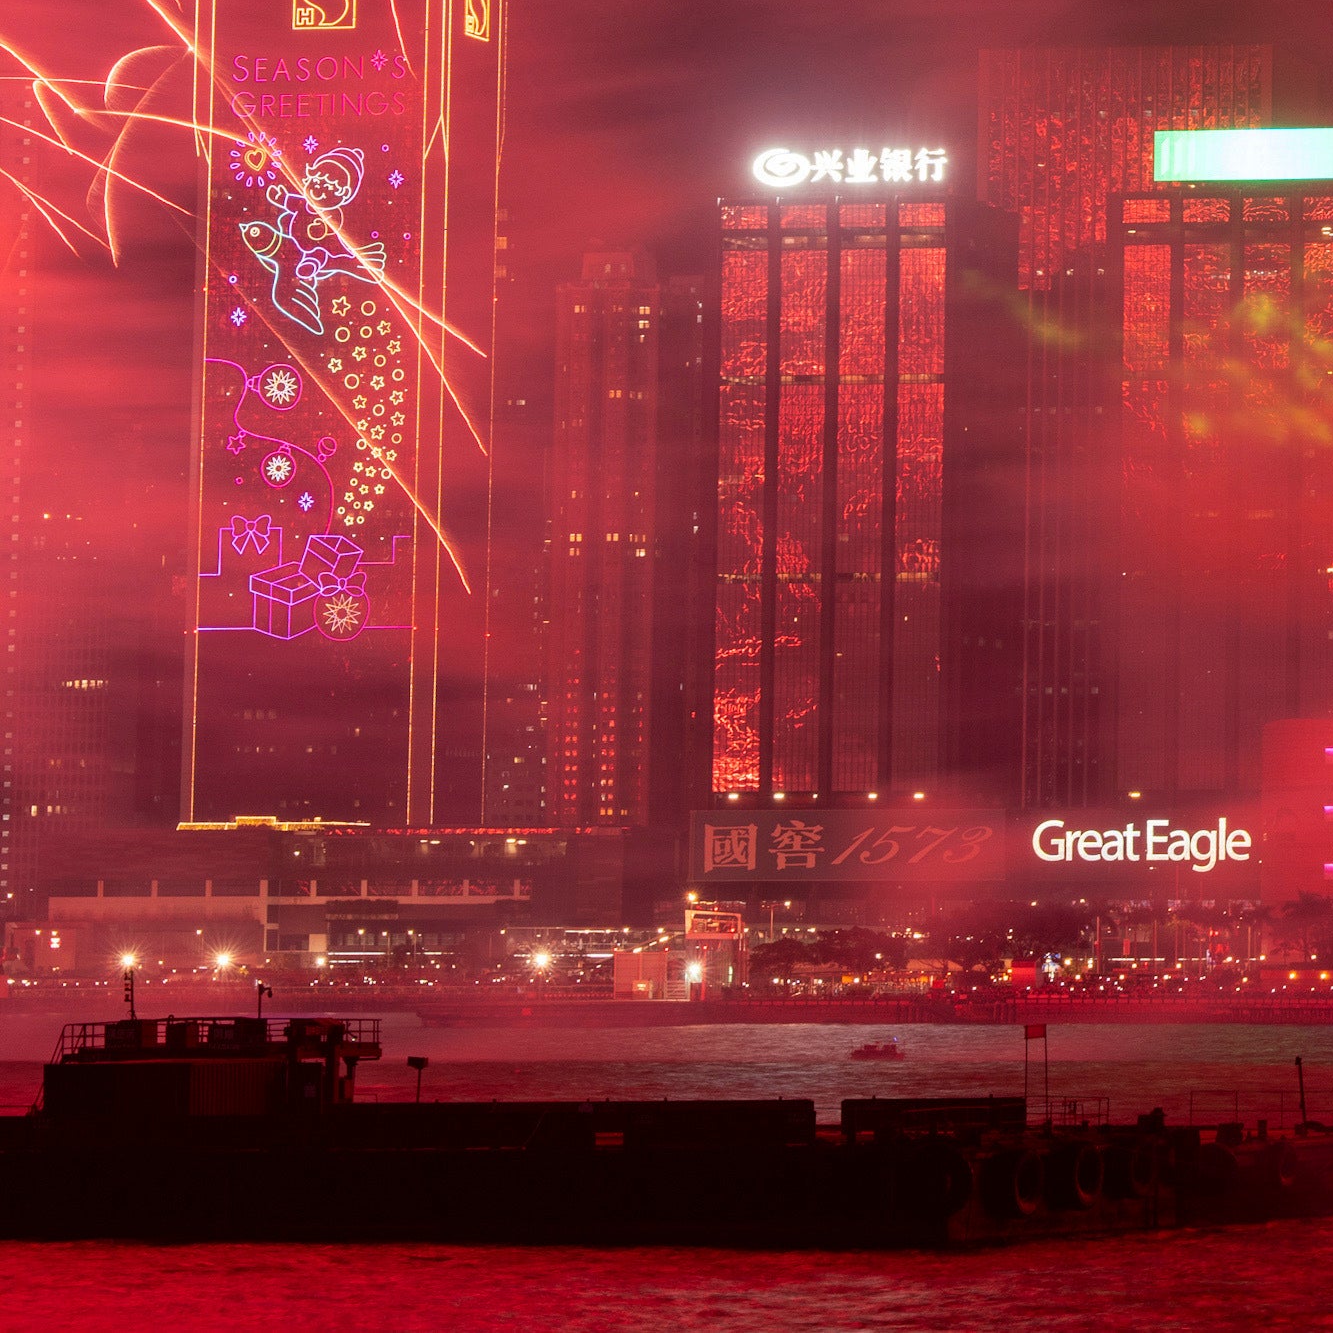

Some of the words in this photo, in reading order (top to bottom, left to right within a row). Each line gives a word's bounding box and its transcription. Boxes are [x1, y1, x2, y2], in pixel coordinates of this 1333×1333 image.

[231, 91, 406, 118] GREETINGS
[811, 147, 949, 183] 兴业银行
[704, 819, 825, 874] 國窖
[831, 823, 994, 866] 1573
[1031, 818, 1141, 863] Great
[1144, 816, 1252, 873] Eagle
